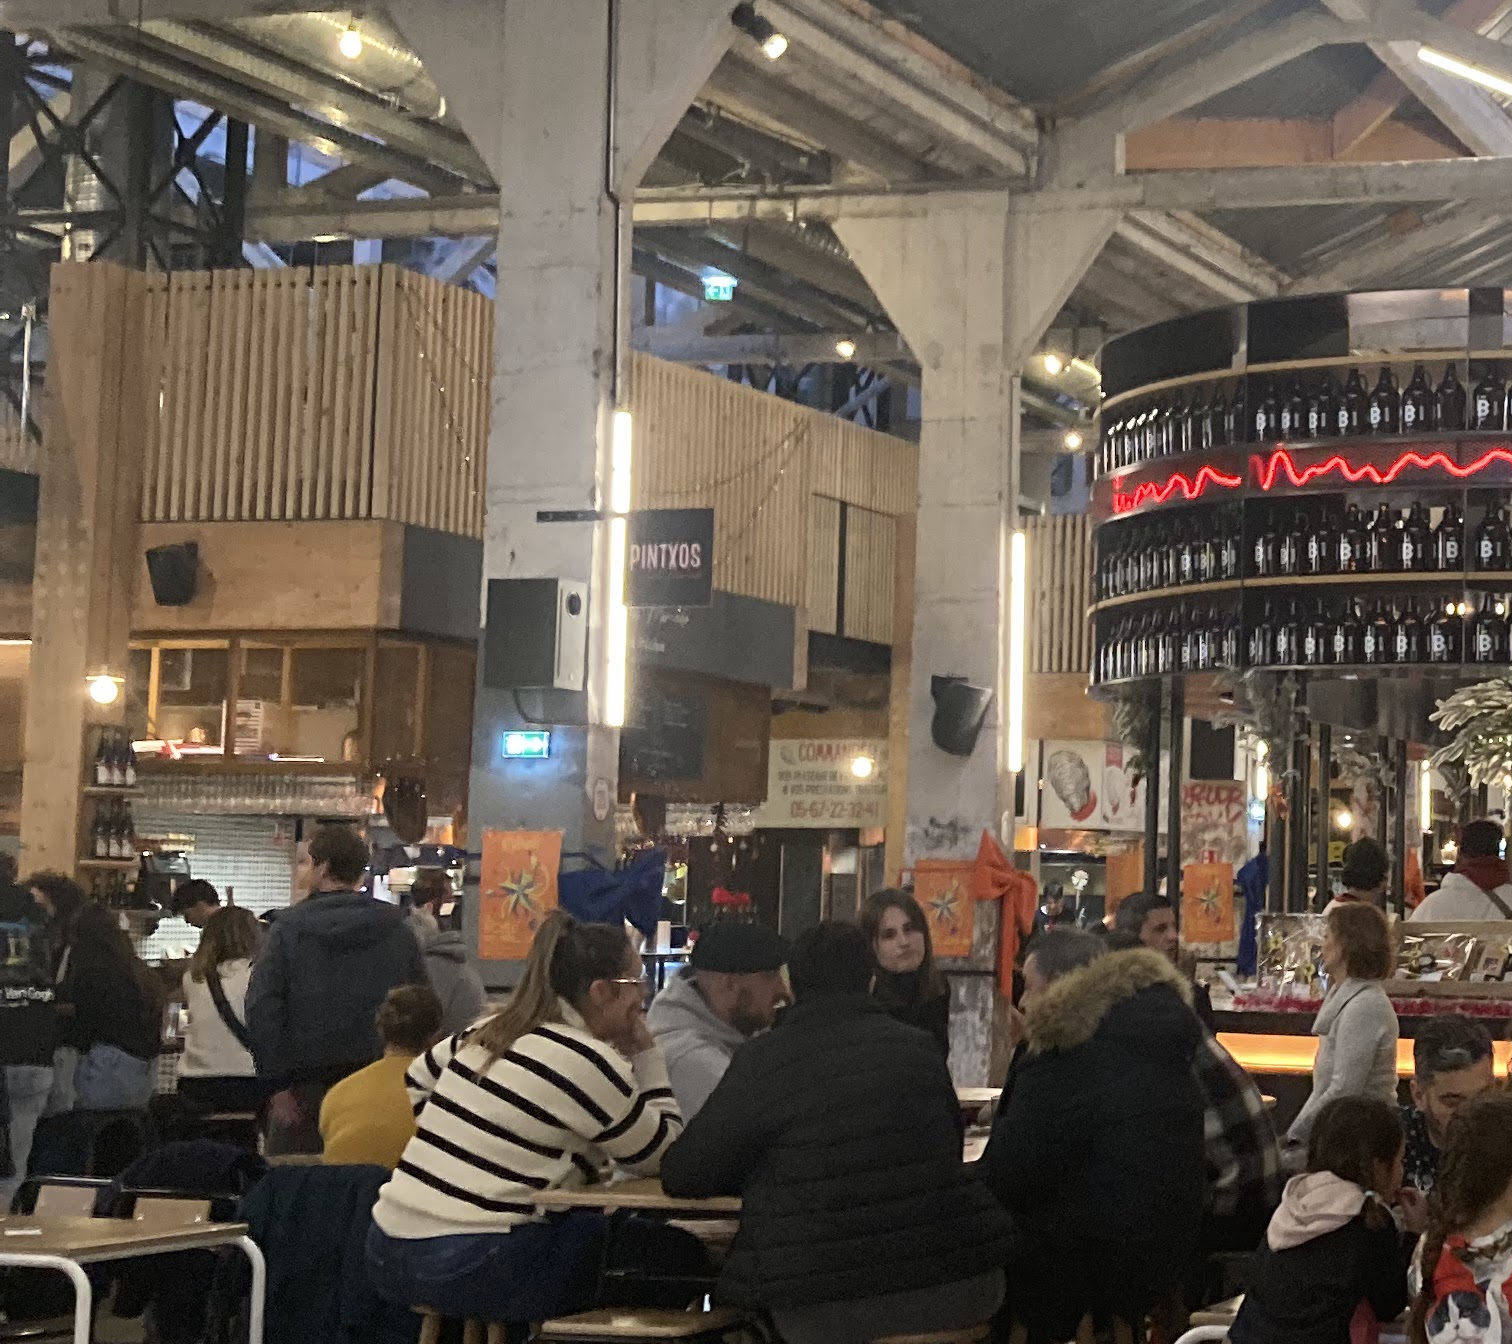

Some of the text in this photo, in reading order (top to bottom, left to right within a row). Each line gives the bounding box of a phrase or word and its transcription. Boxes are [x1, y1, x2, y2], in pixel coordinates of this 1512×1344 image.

[1370, 406, 1380, 424] B
[1404, 405, 1415, 423] B
[1477, 399, 1489, 418] B
[1338, 410, 1349, 428] B
[630, 542, 701, 571] PINTXOS
[1341, 543, 1351, 560] B
[1403, 542, 1414, 559] B
[1447, 542, 1458, 559] B
[1481, 540, 1493, 558] B
[1365, 636, 1375, 653] B
[1397, 636, 1408, 653] B
[1433, 634, 1445, 652] B
[1479, 634, 1491, 652] B
